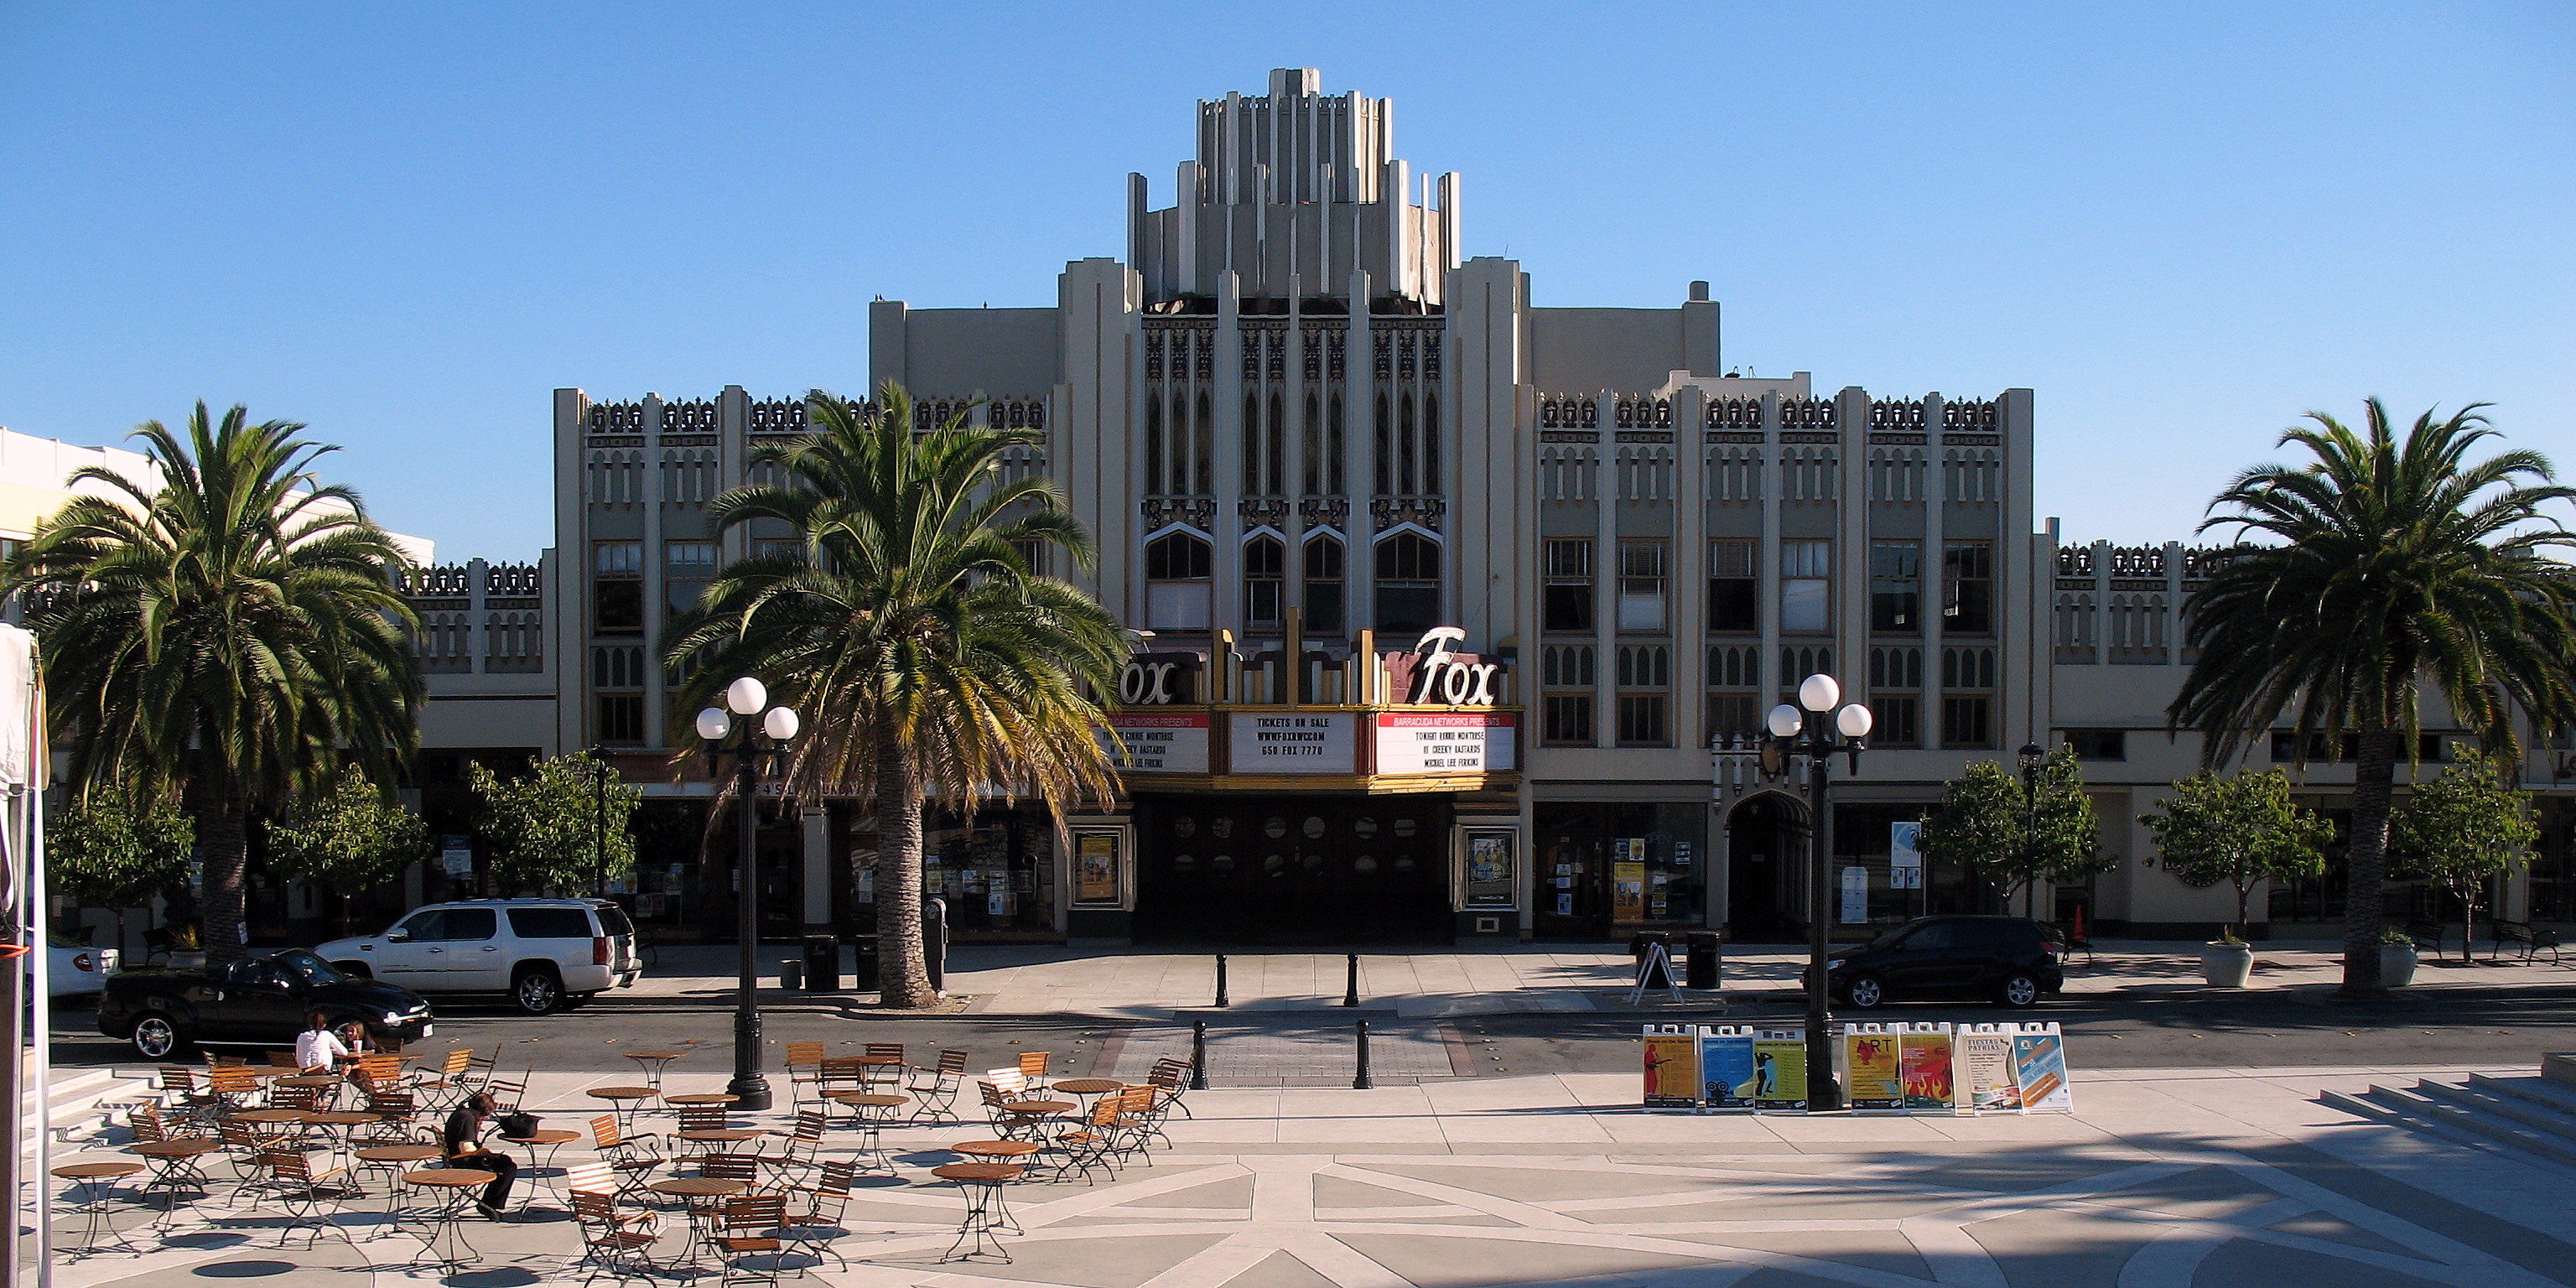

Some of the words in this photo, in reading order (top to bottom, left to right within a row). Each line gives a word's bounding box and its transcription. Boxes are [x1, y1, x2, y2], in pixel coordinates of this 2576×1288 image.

[1414, 626, 1498, 705] Fox
[1119, 662, 1176, 705] ox
[1257, 718, 1291, 728] TICKETS
[1295, 718, 1306, 728] ON
[1310, 718, 1330, 728] SALE
[1393, 717, 1433, 726] BARRACUDA
[1261, 745, 1278, 756] 650
[1282, 745, 1297, 756] FOX
[1301, 745, 1322, 756] 7770
[1446, 758, 1457, 767] LEE
